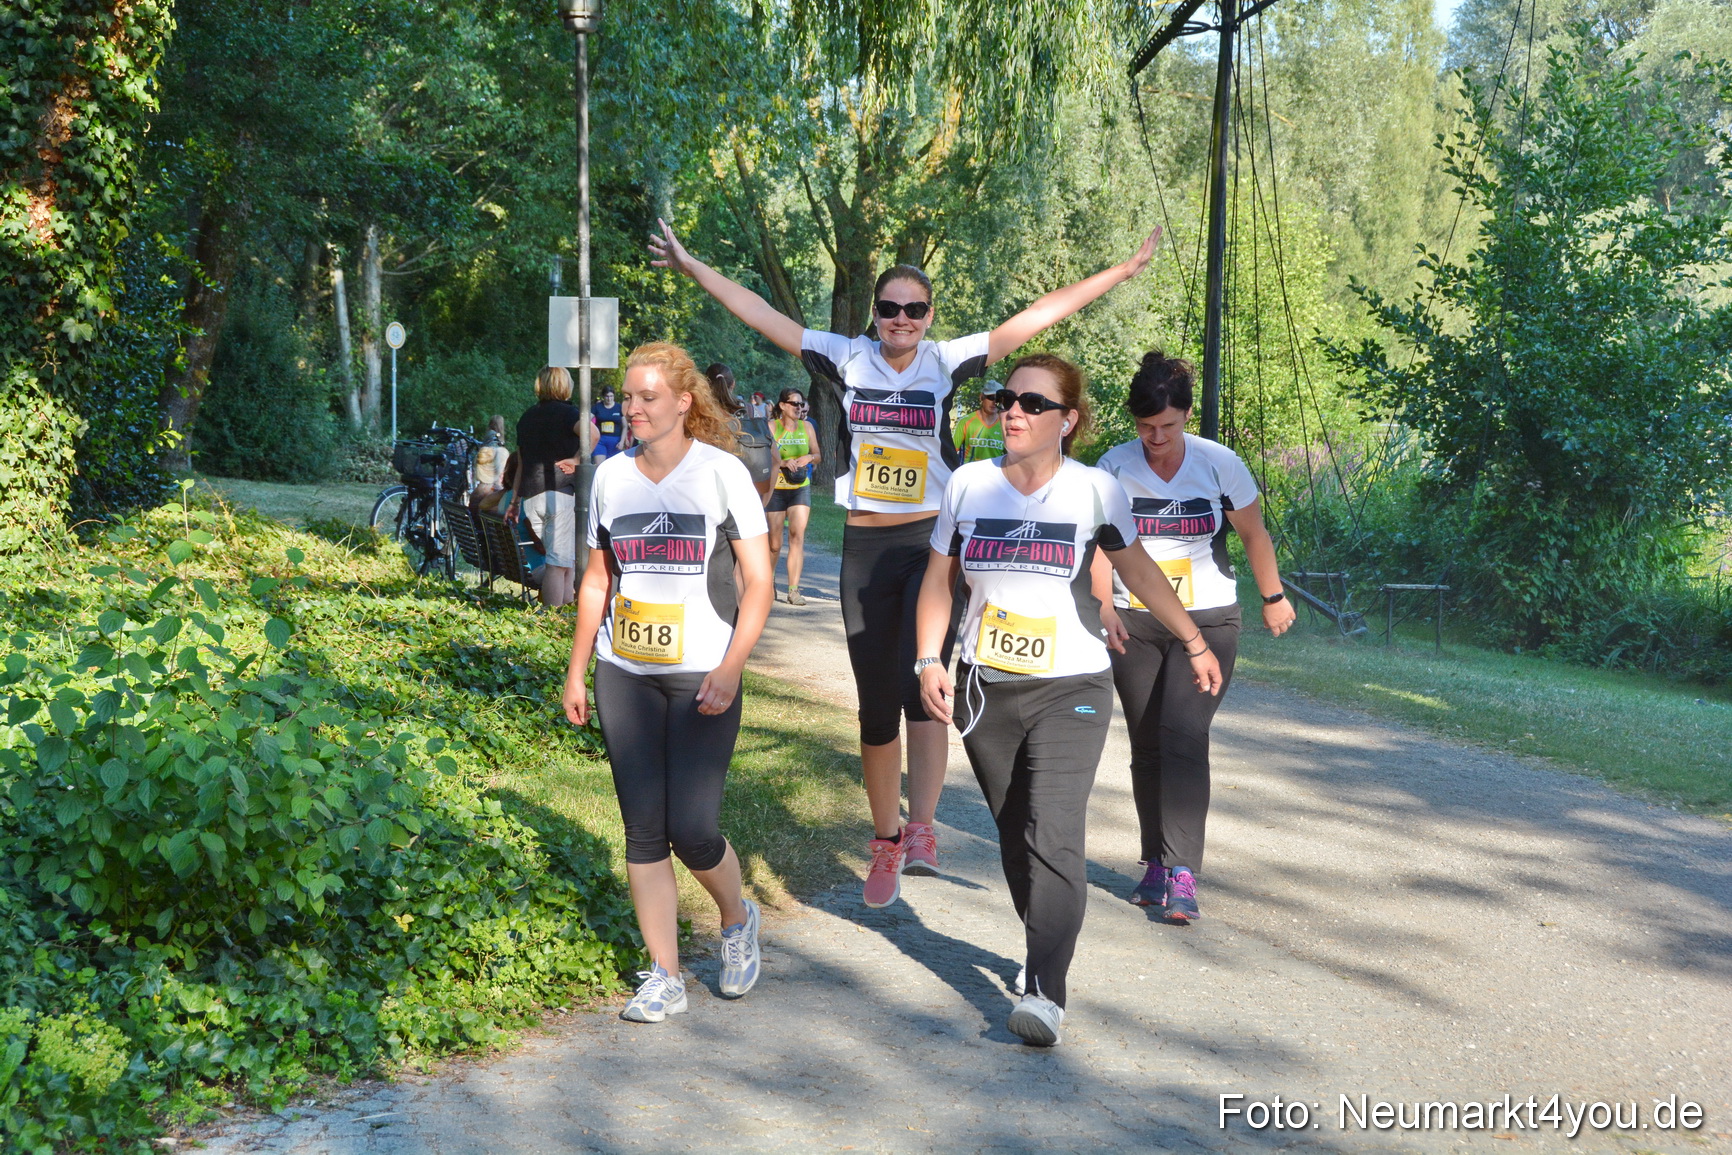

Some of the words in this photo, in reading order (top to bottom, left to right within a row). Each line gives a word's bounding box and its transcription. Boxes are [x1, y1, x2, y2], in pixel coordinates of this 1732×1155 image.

[852, 425, 931, 435] ZEITARBEIT
[866, 463, 917, 488] 1619
[622, 564, 699, 572] EITARBEIT
[967, 562, 1070, 574] ZEITARBEIT
[619, 617, 672, 647] 1618
[637, 644, 666, 653] Christina
[989, 628, 1045, 659] 1620
[994, 651, 1015, 662] Karoza
